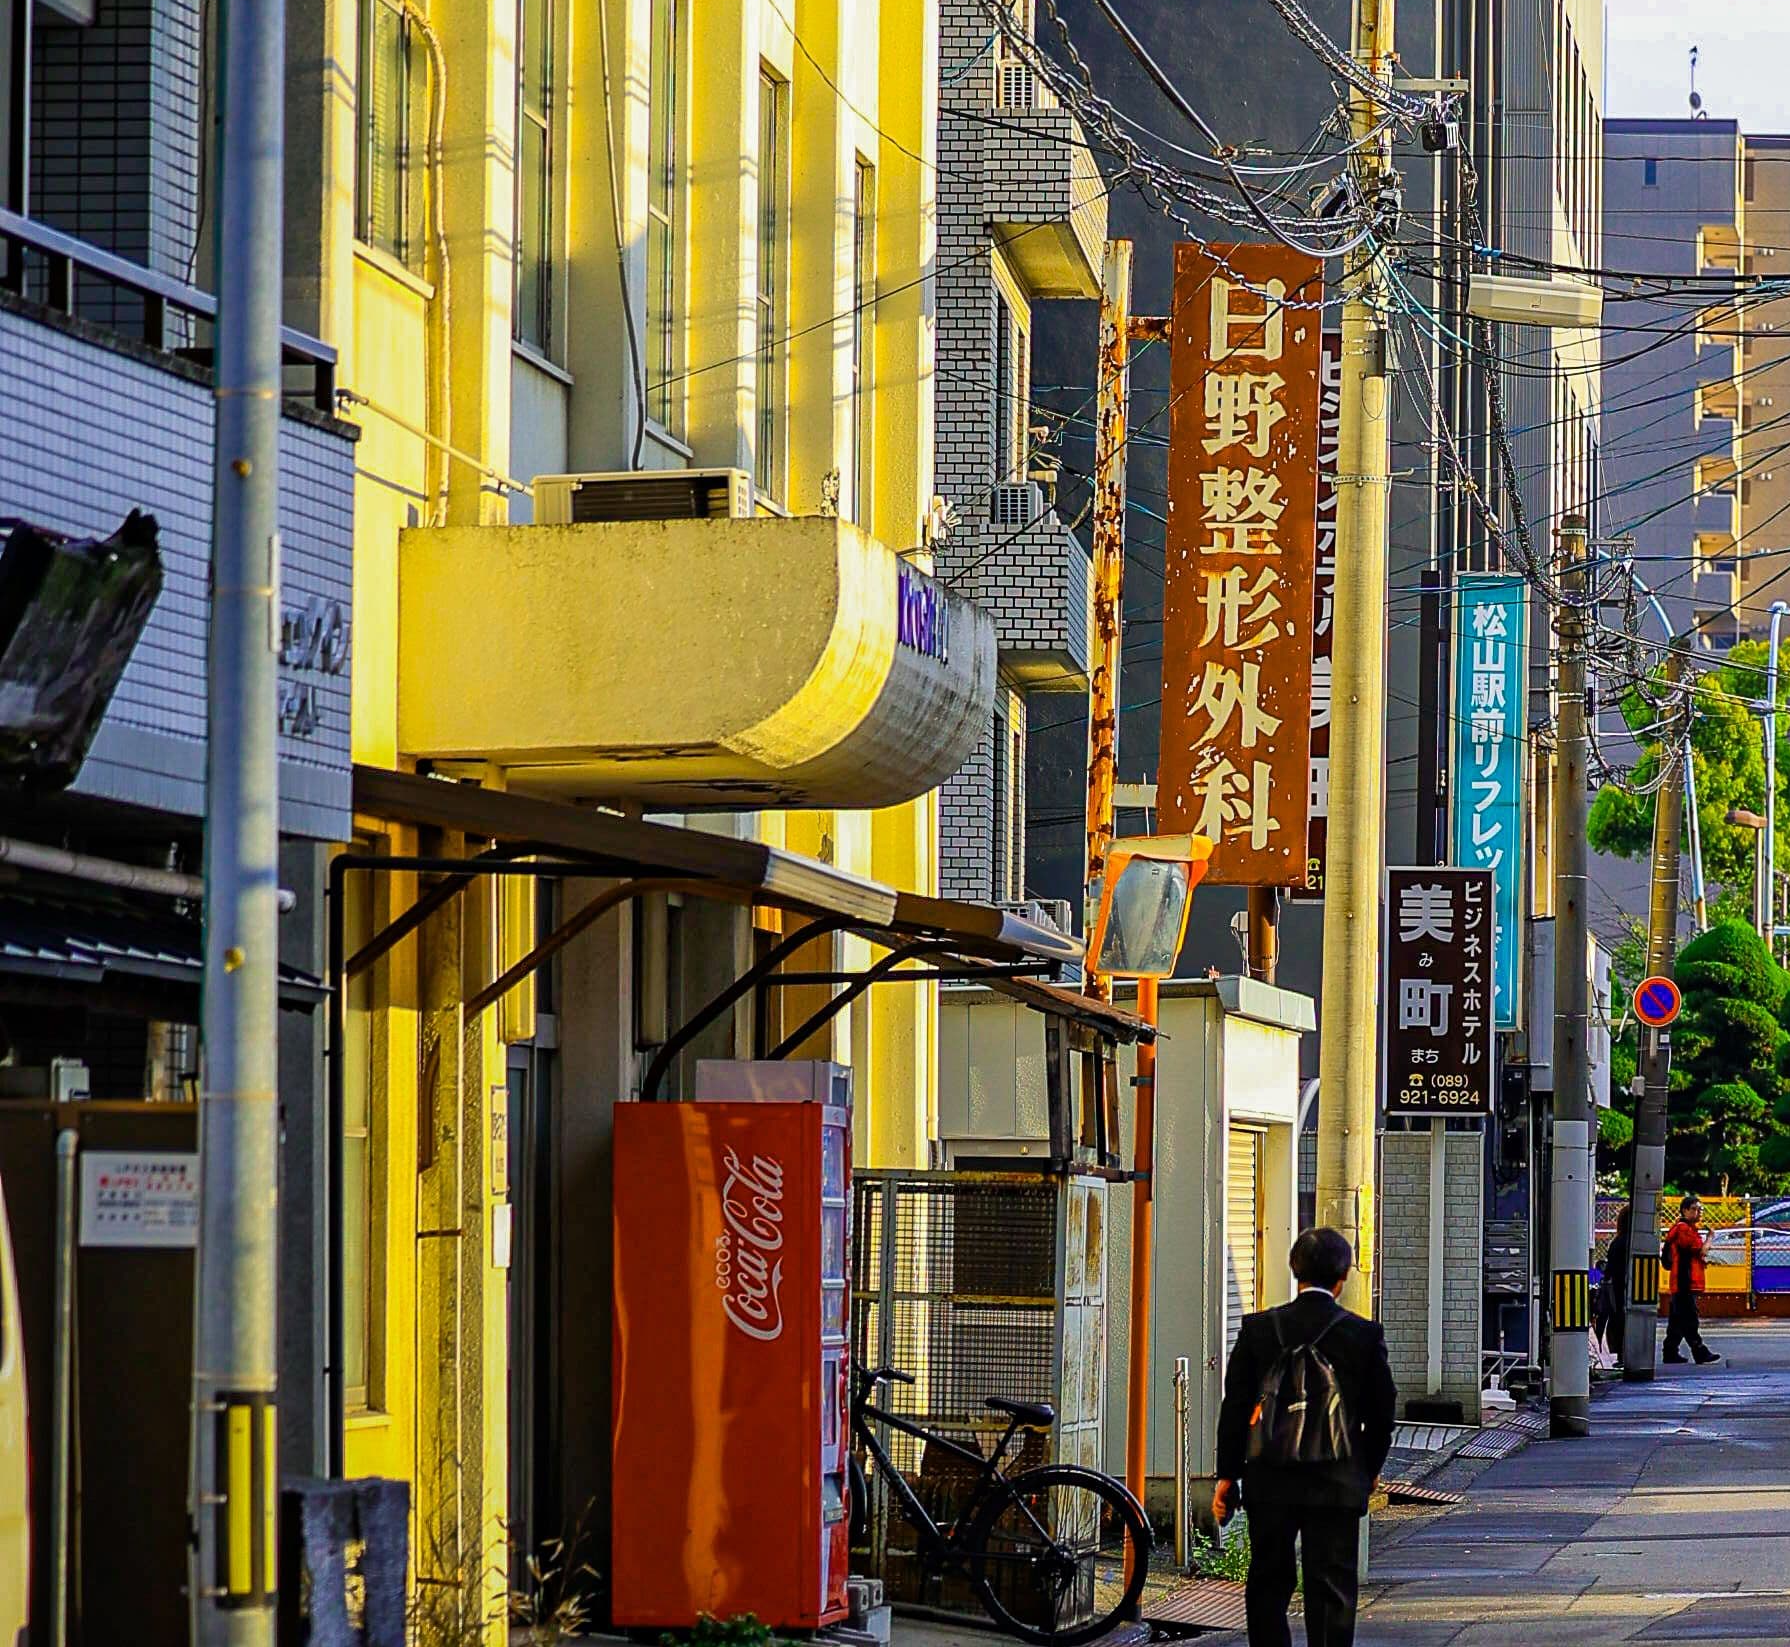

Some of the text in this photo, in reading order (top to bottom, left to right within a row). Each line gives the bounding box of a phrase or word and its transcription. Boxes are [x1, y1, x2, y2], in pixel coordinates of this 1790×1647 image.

[1186, 276, 1287, 851] 日野整形外科
[1470, 601, 1508, 1000] 松山駅前リフレッ
[1462, 881, 1483, 1065] ビジネスホテル
[1399, 1090, 1481, 1105] 921-6924
[1431, 1074, 1470, 1088] (089)
[722, 1144, 784, 1341] Coca-Cola
